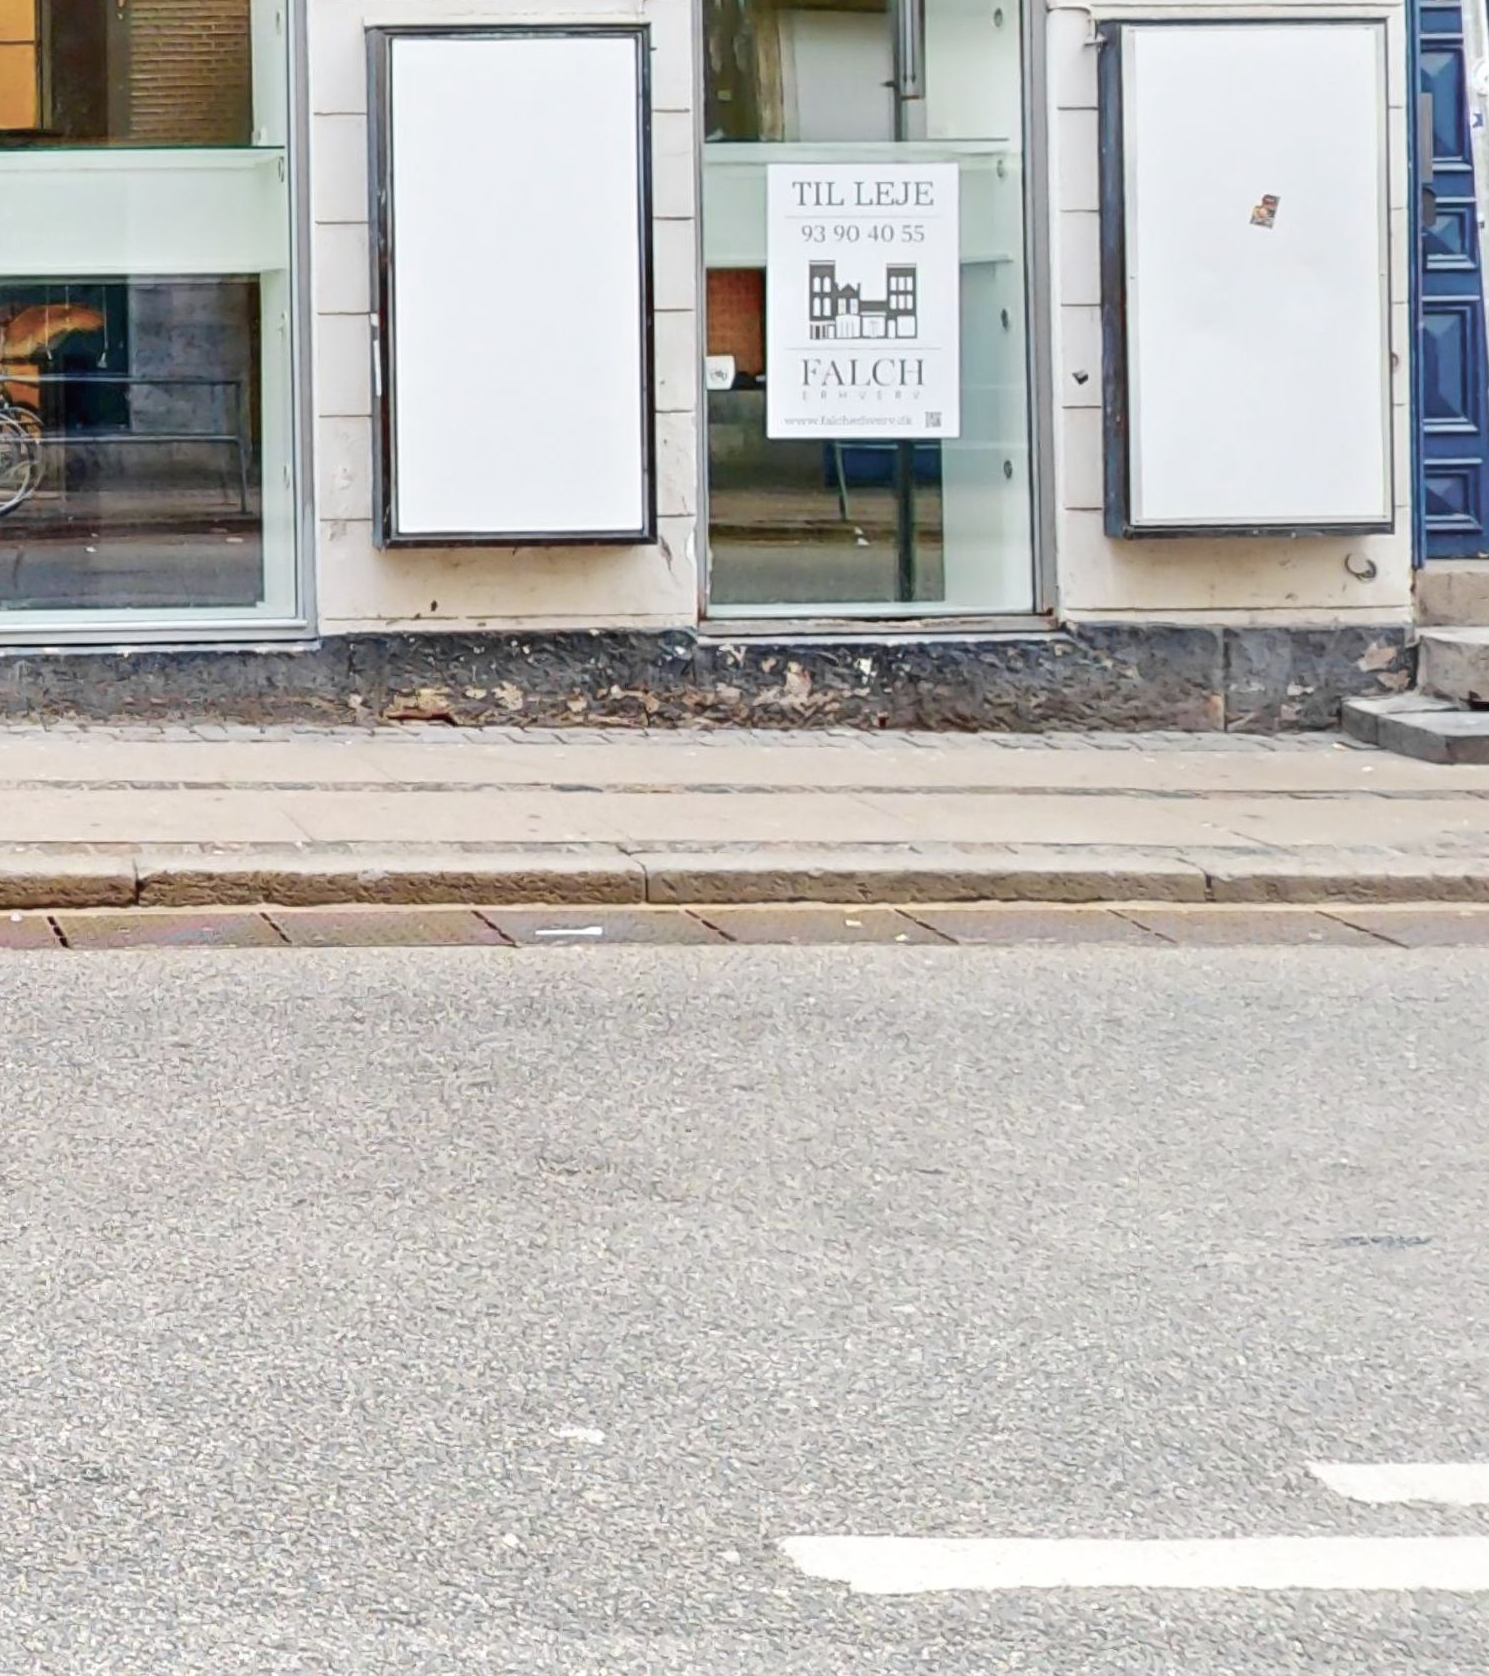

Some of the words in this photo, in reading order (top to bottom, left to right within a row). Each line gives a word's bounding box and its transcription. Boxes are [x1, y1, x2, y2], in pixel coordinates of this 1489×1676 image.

[791, 181, 845, 206] TIL
[854, 181, 934, 207] LEJE
[801, 225, 826, 243] 93
[833, 225, 860, 243] 90
[868, 225, 894, 243] 40
[901, 225, 925, 243] 55
[802, 358, 925, 386] FALCH
